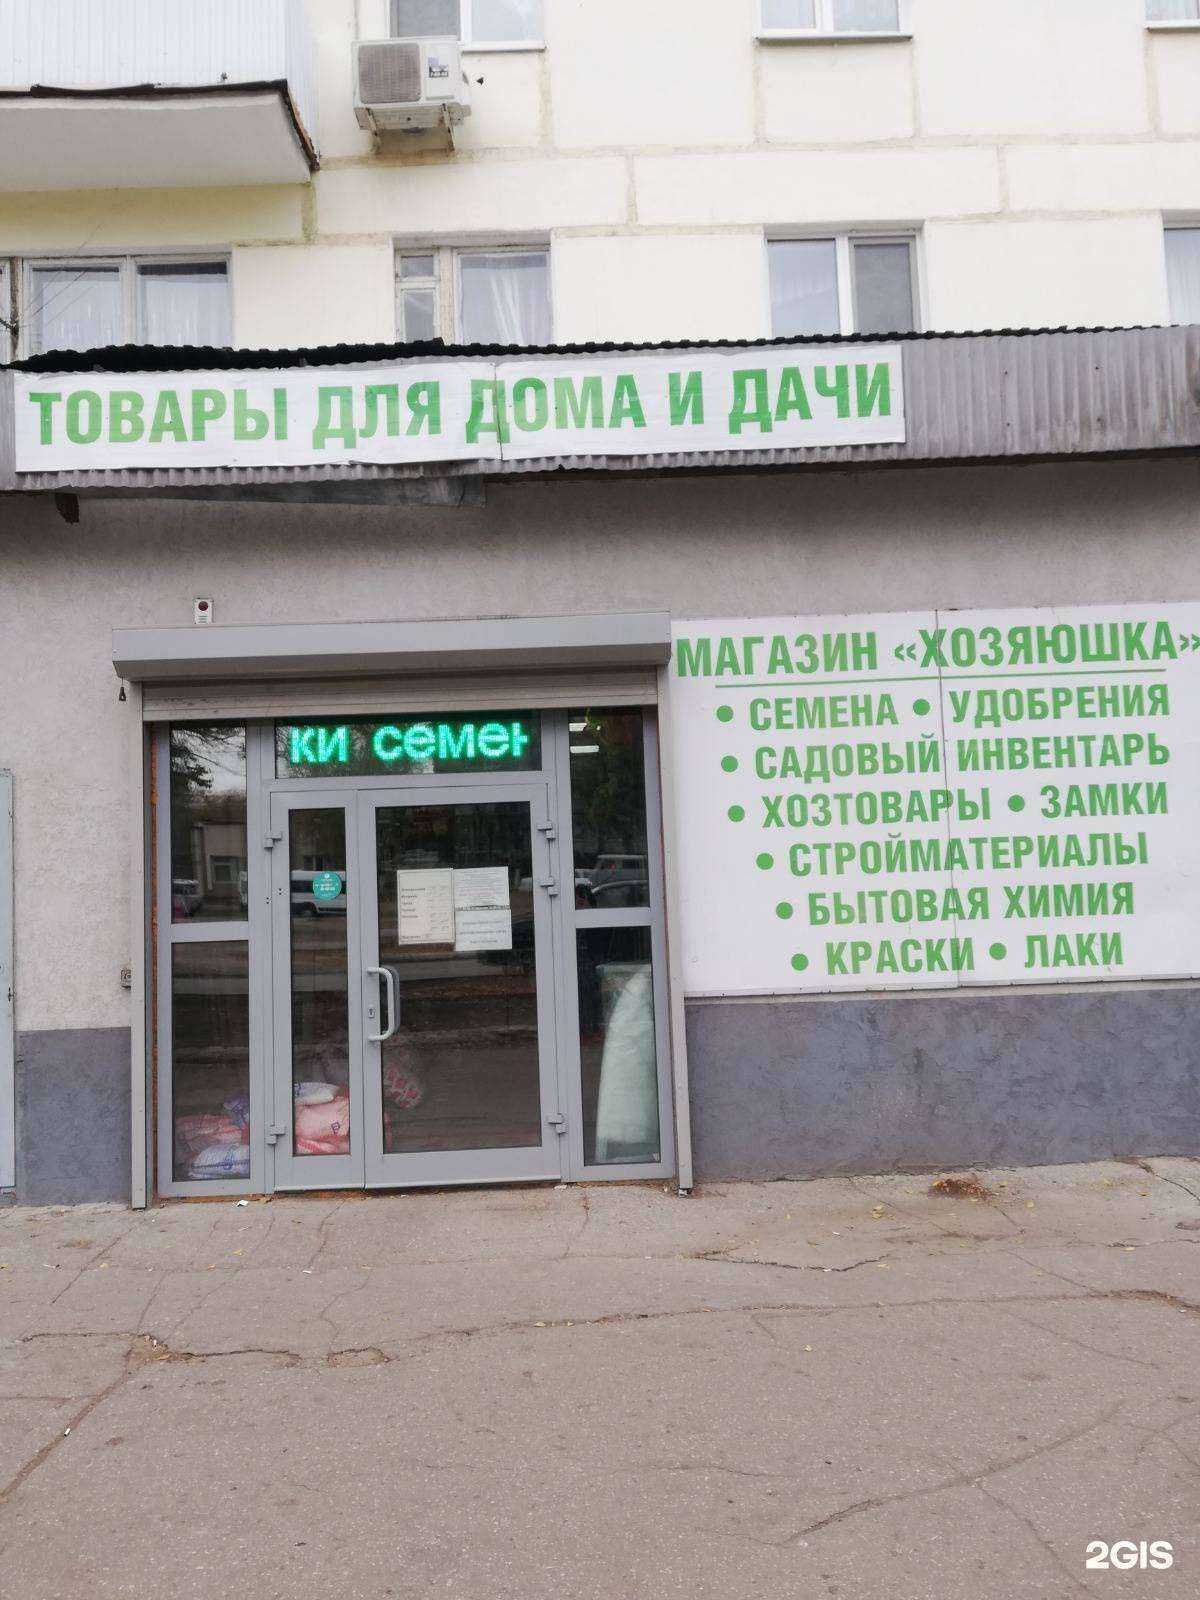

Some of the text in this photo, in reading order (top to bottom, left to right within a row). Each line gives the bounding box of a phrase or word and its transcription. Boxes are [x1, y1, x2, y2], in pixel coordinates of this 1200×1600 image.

[28, 362, 891, 449] ТОВАРЫ ДЛЯ ДОМА И ДАЧИ
[676, 620, 1200, 678] МАГАЗИН «ХОЗЯЮШКА»
[748, 684, 1169, 732] СЕМЕНА УДОБРЕНИЯ
[289, 724, 351, 766] ки
[753, 731, 1171, 784] САДОВЫЙ ИНВЕНТАРЬ
[762, 780, 1168, 829] ХОЗТОВАРЫ ЗАМКИ
[789, 831, 1149, 876] СТРОЙМАТЕРИАЛЫ
[808, 881, 1135, 926] БЫТОВАЯ ХИМИЯ
[826, 931, 1125, 976] КРАСКИ ЛАКИ
